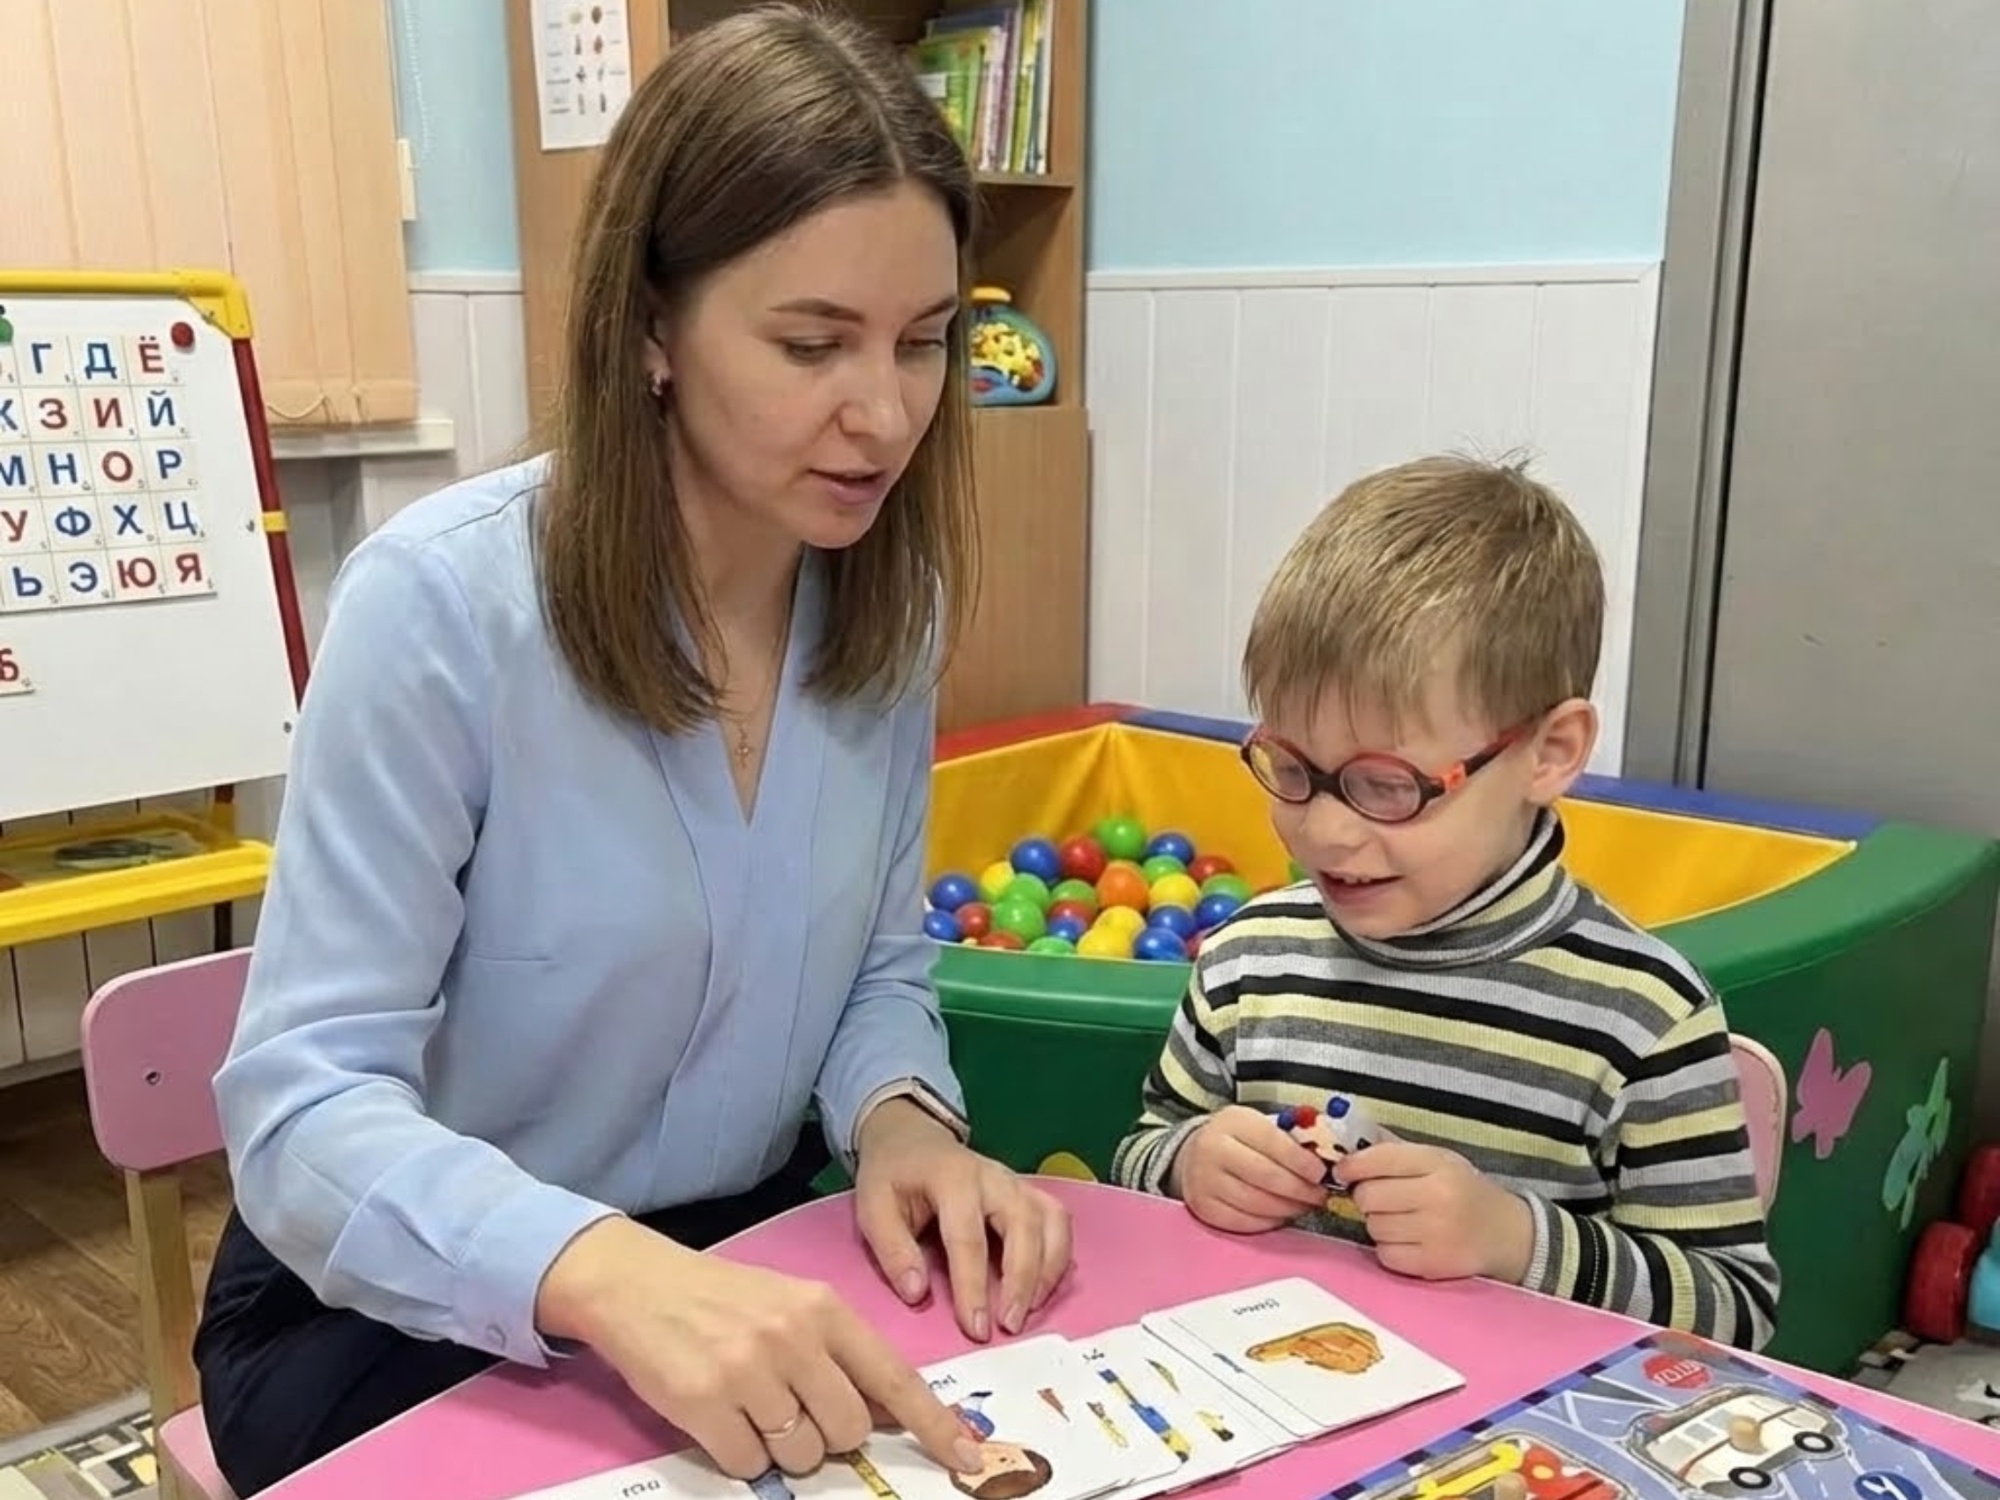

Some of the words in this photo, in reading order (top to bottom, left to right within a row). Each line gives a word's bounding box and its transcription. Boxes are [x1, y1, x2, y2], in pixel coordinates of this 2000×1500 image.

[32, 344, 51, 373] Г
[85, 343, 117, 379] Д
[139, 336, 163, 372] Ё
[39, 399, 67, 429] З
[94, 398, 122, 428] И
[148, 391, 175, 426] Й
[0, 456, 26, 486] М
[48, 453, 77, 484] Н
[103, 451, 132, 482] О
[157, 450, 181, 479] Р
[1, 511, 27, 541] У
[55, 507, 91, 536] Ф
[114, 505, 142, 535] Х
[164, 502, 197, 535] Ц
[13, 567, 42, 596] Ь
[69, 562, 97, 592] Э
[117, 558, 156, 588] Ю
[176, 554, 201, 582] Я
